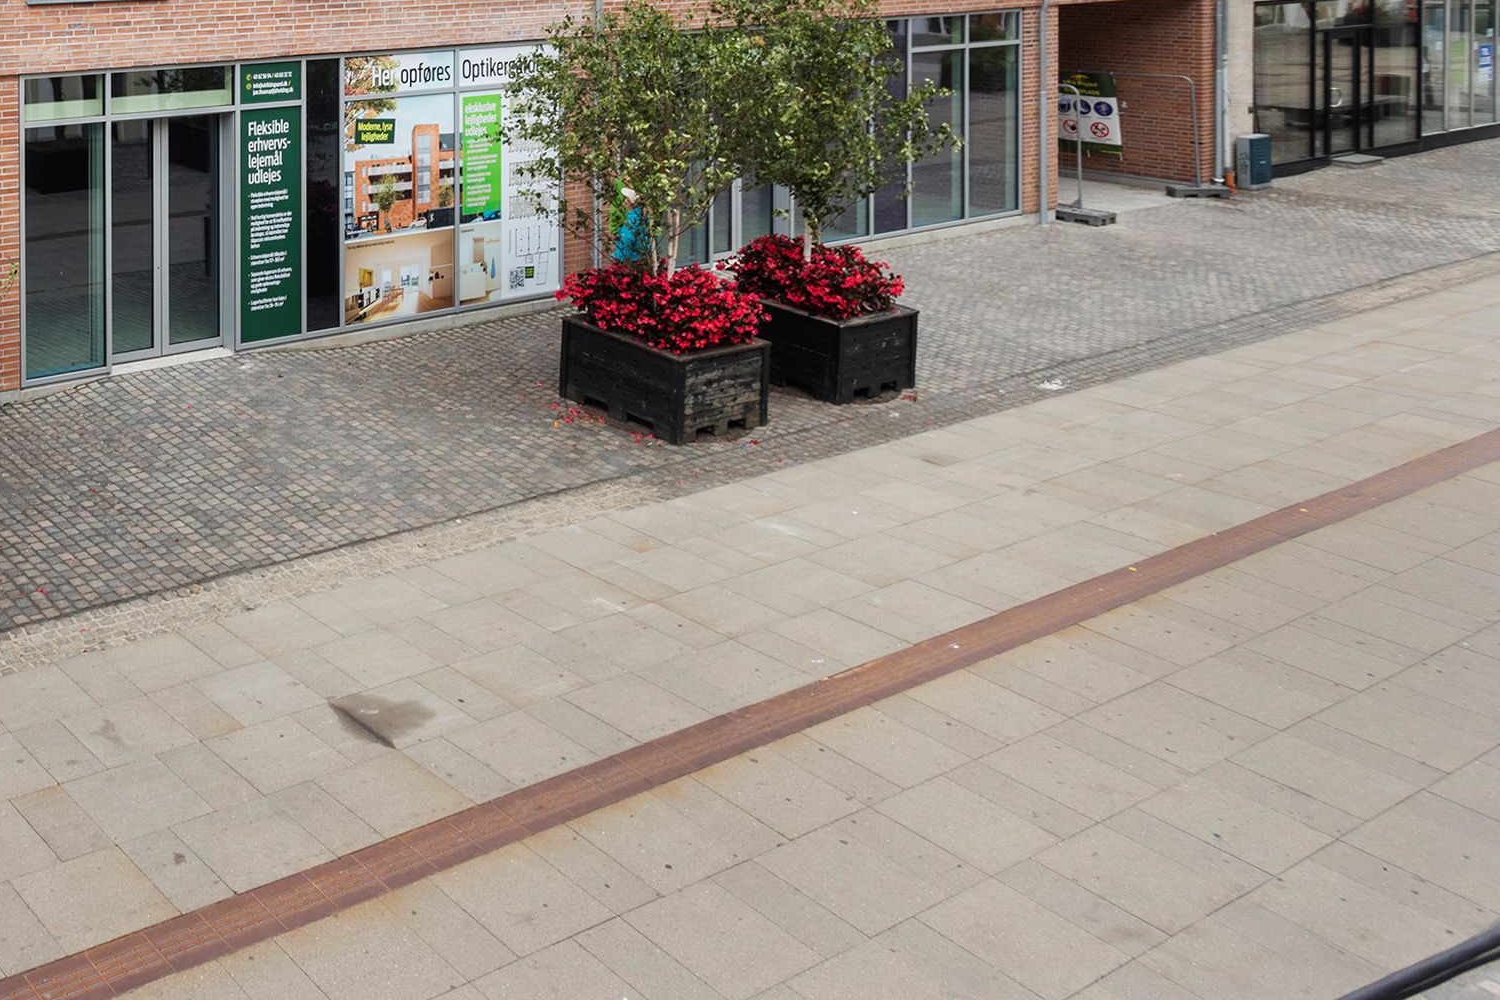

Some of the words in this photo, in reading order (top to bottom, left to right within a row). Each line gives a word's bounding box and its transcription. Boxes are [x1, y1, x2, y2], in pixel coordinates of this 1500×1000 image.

[371, 66, 396, 88] Her
[400, 62, 450, 87] opføres
[248, 119, 289, 136] Fleksible
[248, 137, 291, 152] erhvervs-
[248, 151, 283, 170] lejemål
[248, 168, 282, 185] udlejes
